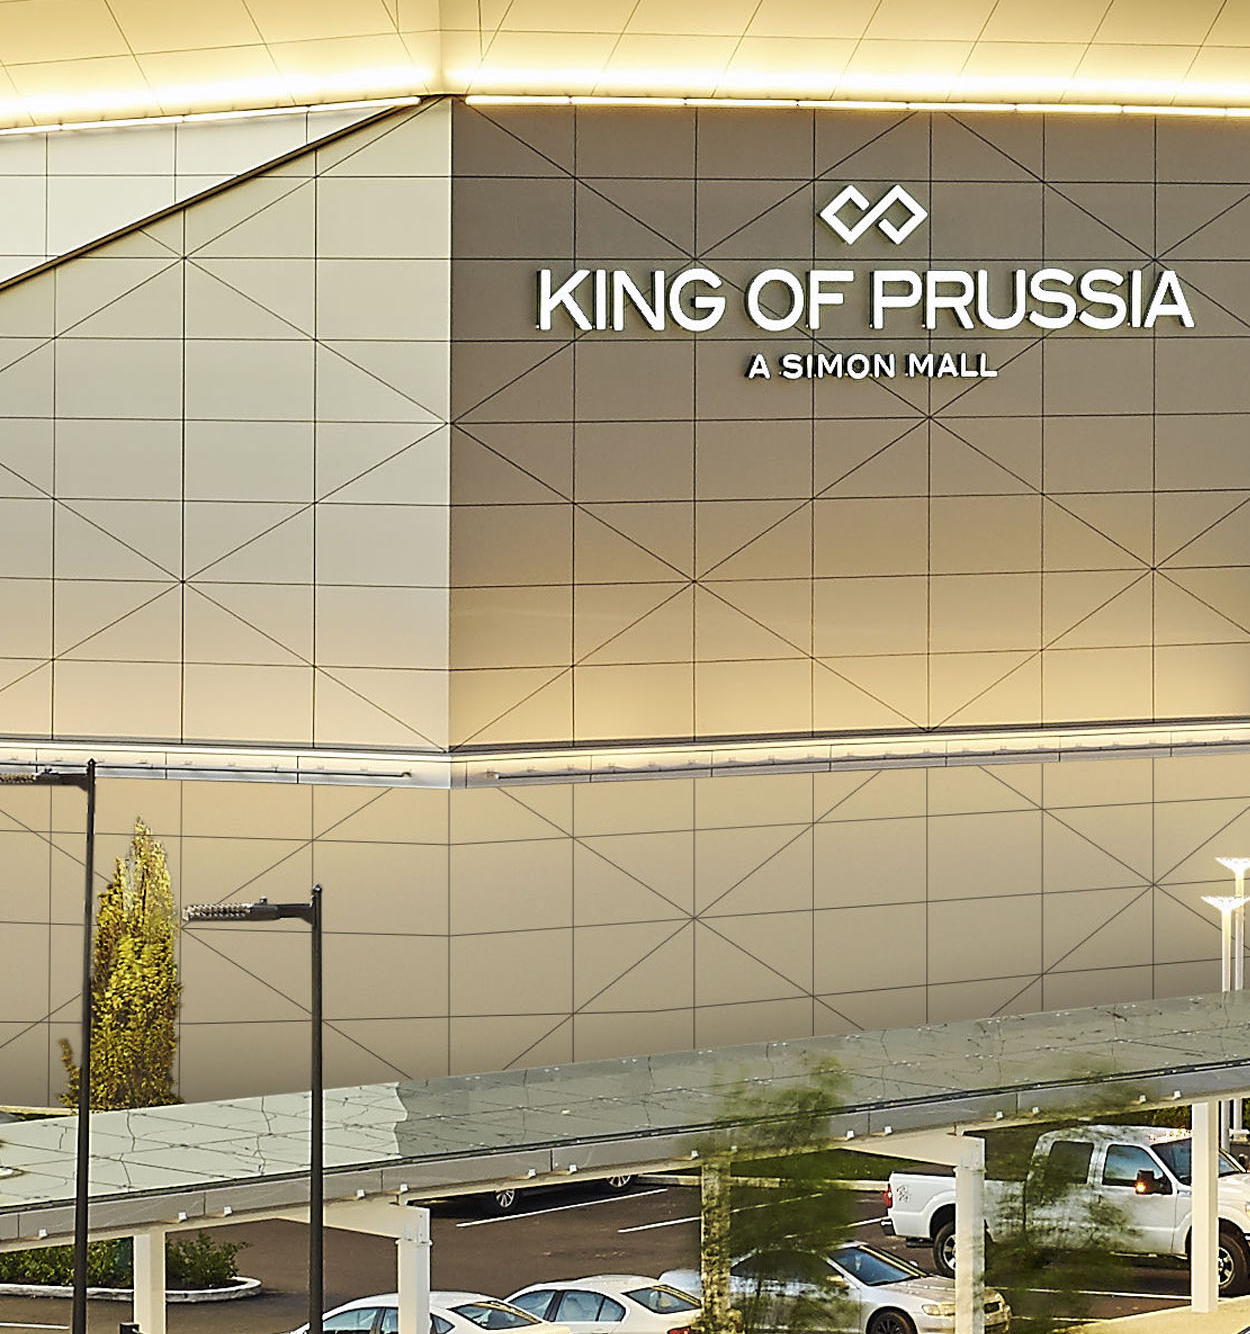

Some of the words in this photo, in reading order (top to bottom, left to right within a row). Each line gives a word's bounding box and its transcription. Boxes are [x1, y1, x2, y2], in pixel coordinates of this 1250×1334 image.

[536, 268, 726, 332] KING
[744, 268, 854, 332] OF
[869, 268, 1195, 331] PRUSSIA
[747, 353, 771, 379] A
[779, 353, 895, 380] SIMON
[906, 352, 998, 378] MALL
